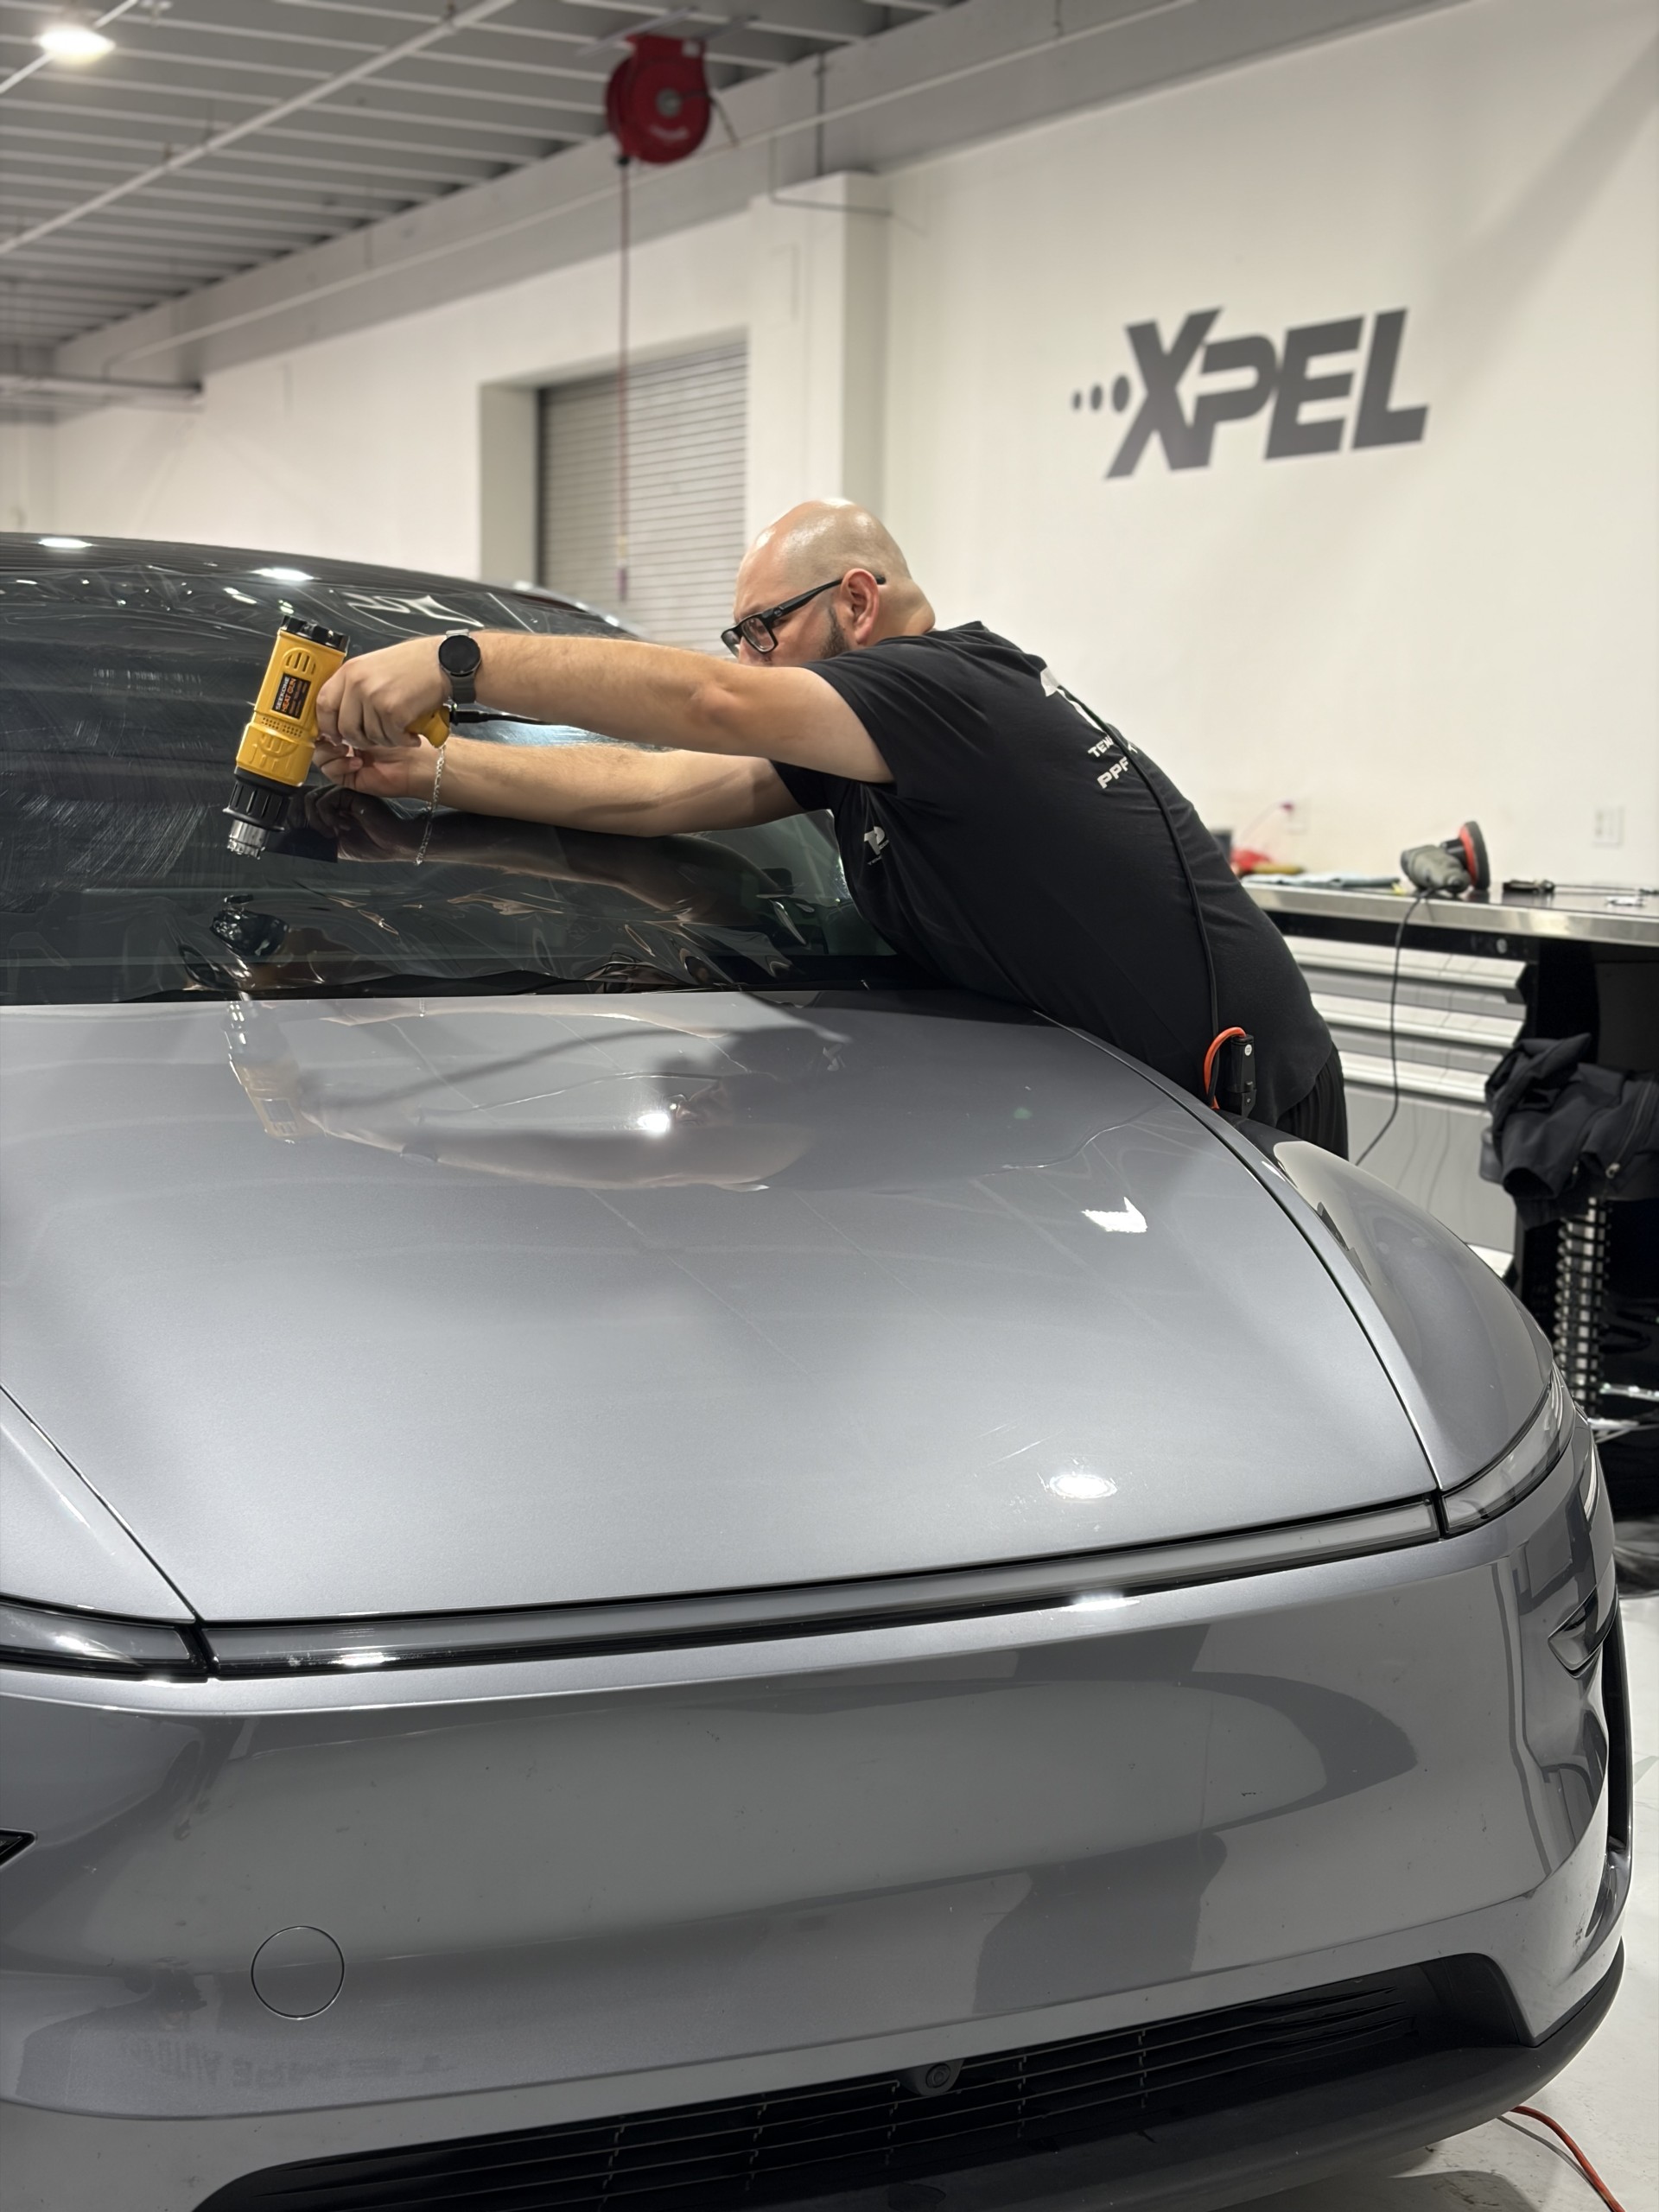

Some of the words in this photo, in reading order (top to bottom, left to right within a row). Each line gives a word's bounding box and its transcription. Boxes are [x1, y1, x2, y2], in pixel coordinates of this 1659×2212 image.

[1105, 307, 1429, 480] XPEL
[281, 693, 291, 713] HEAT
[287, 677, 296, 694] GUN
[1096, 757, 1129, 789] PPF
